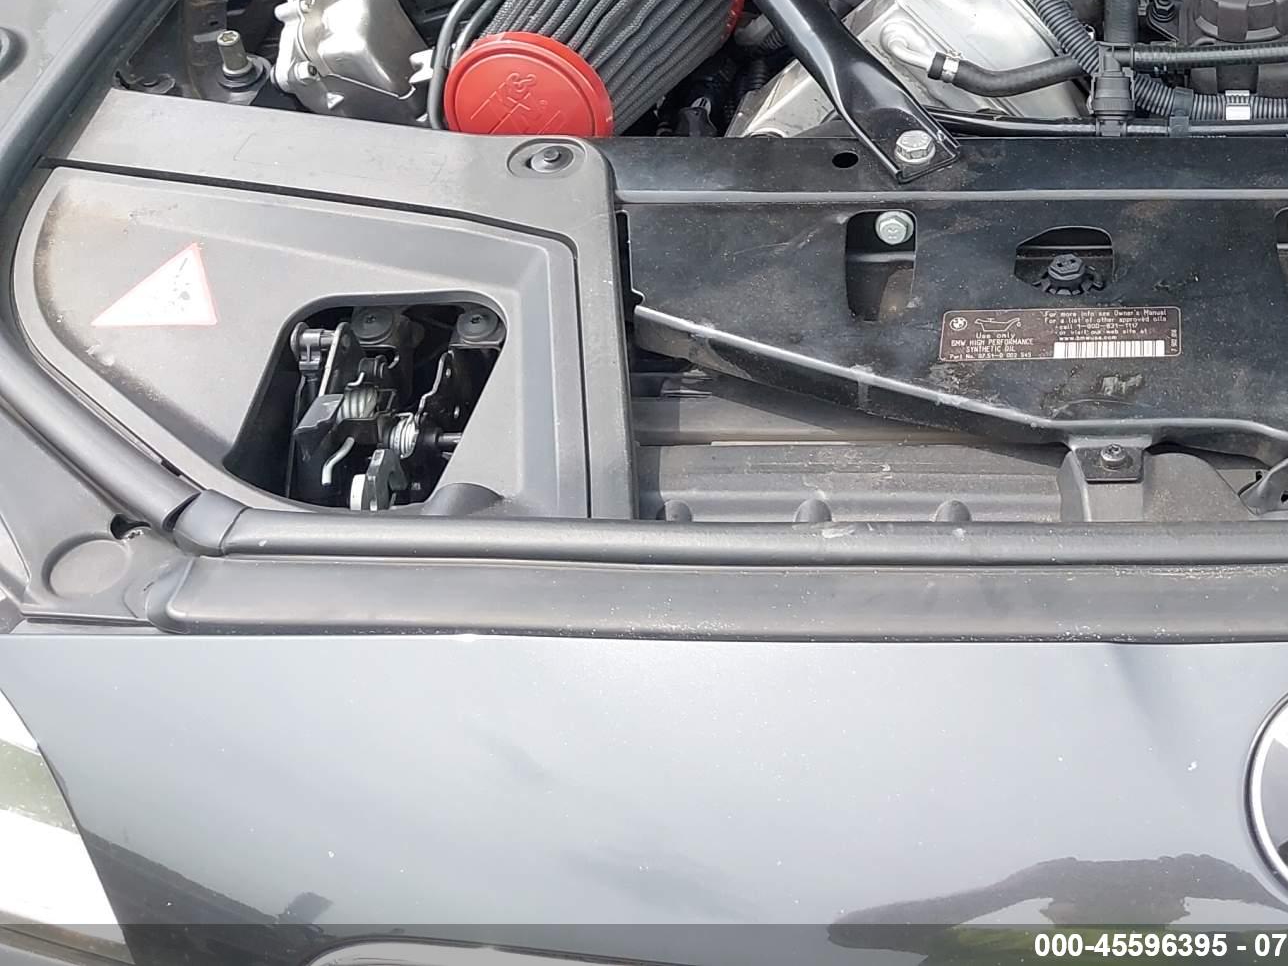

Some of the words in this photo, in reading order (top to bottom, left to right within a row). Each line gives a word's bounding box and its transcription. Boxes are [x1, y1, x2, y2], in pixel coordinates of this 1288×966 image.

[1143, 308, 1167, 316] Manual
[1119, 315, 1150, 323] approved
[996, 331, 1016, 340] only
[951, 339, 966, 347] BMW
[969, 338, 985, 346] HIGH
[988, 337, 1034, 346] PERFORMANCE
[966, 345, 1001, 353] SYNTHETIC
